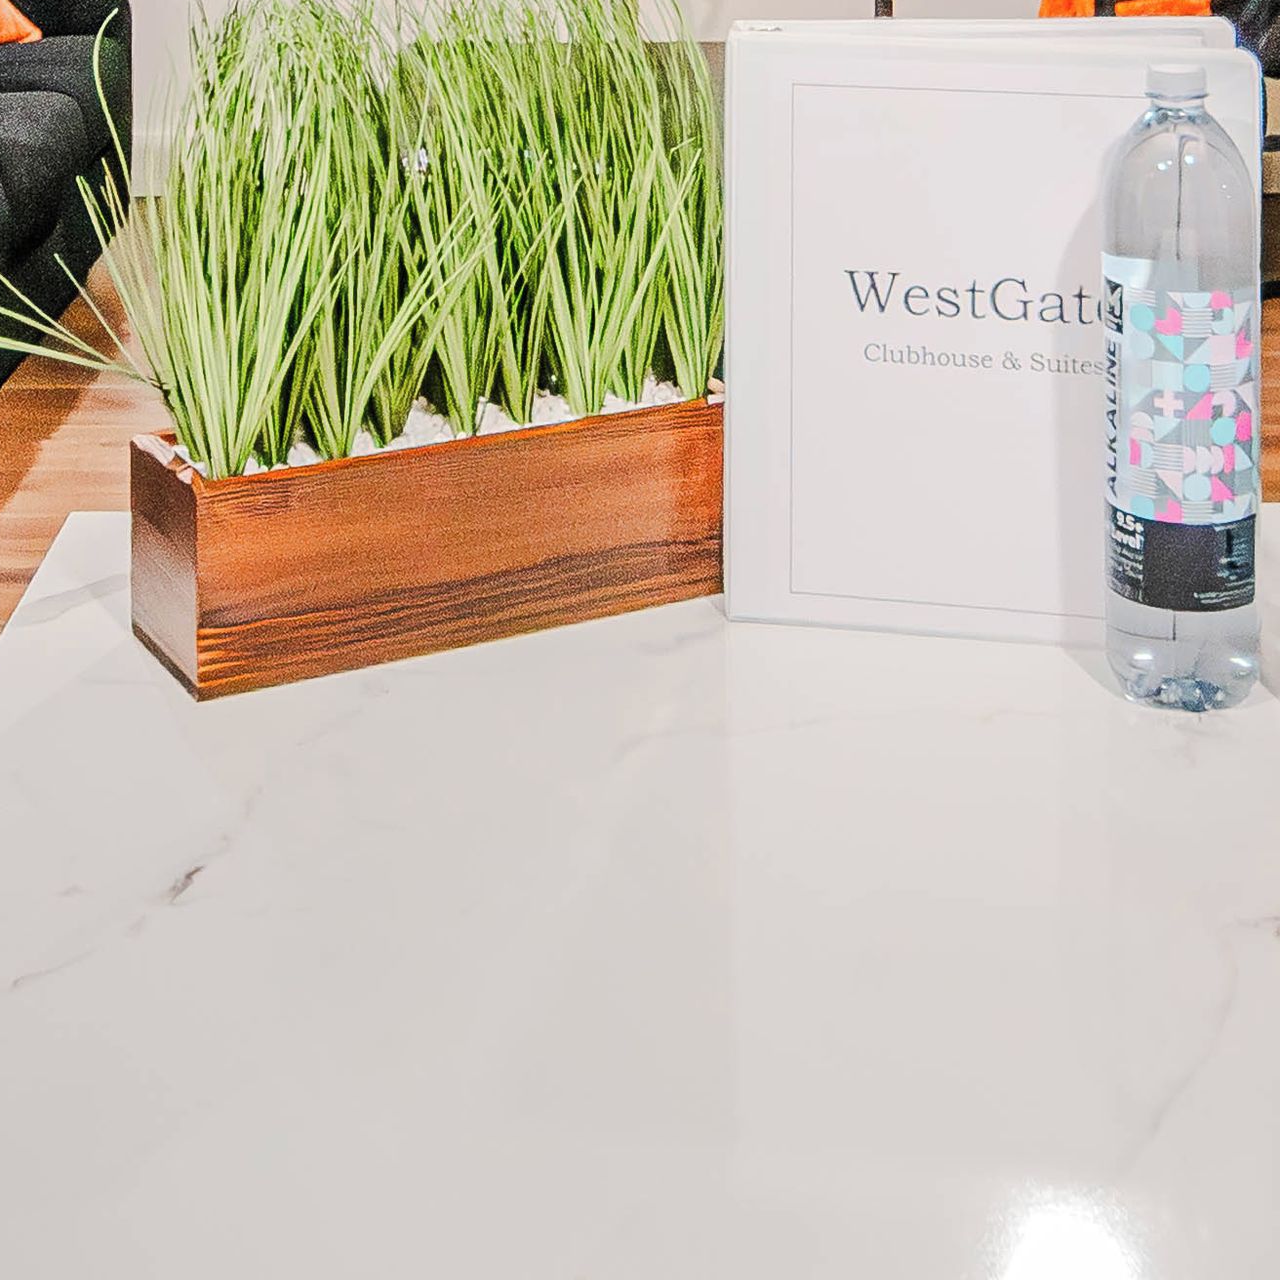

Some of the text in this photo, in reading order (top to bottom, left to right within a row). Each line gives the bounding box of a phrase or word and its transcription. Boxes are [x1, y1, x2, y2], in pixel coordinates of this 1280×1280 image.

[844, 269, 1105, 325] WestGat
[863, 342, 1105, 376] Clubhouse & Suites
[1104, 340, 1118, 498] ALKALINE
